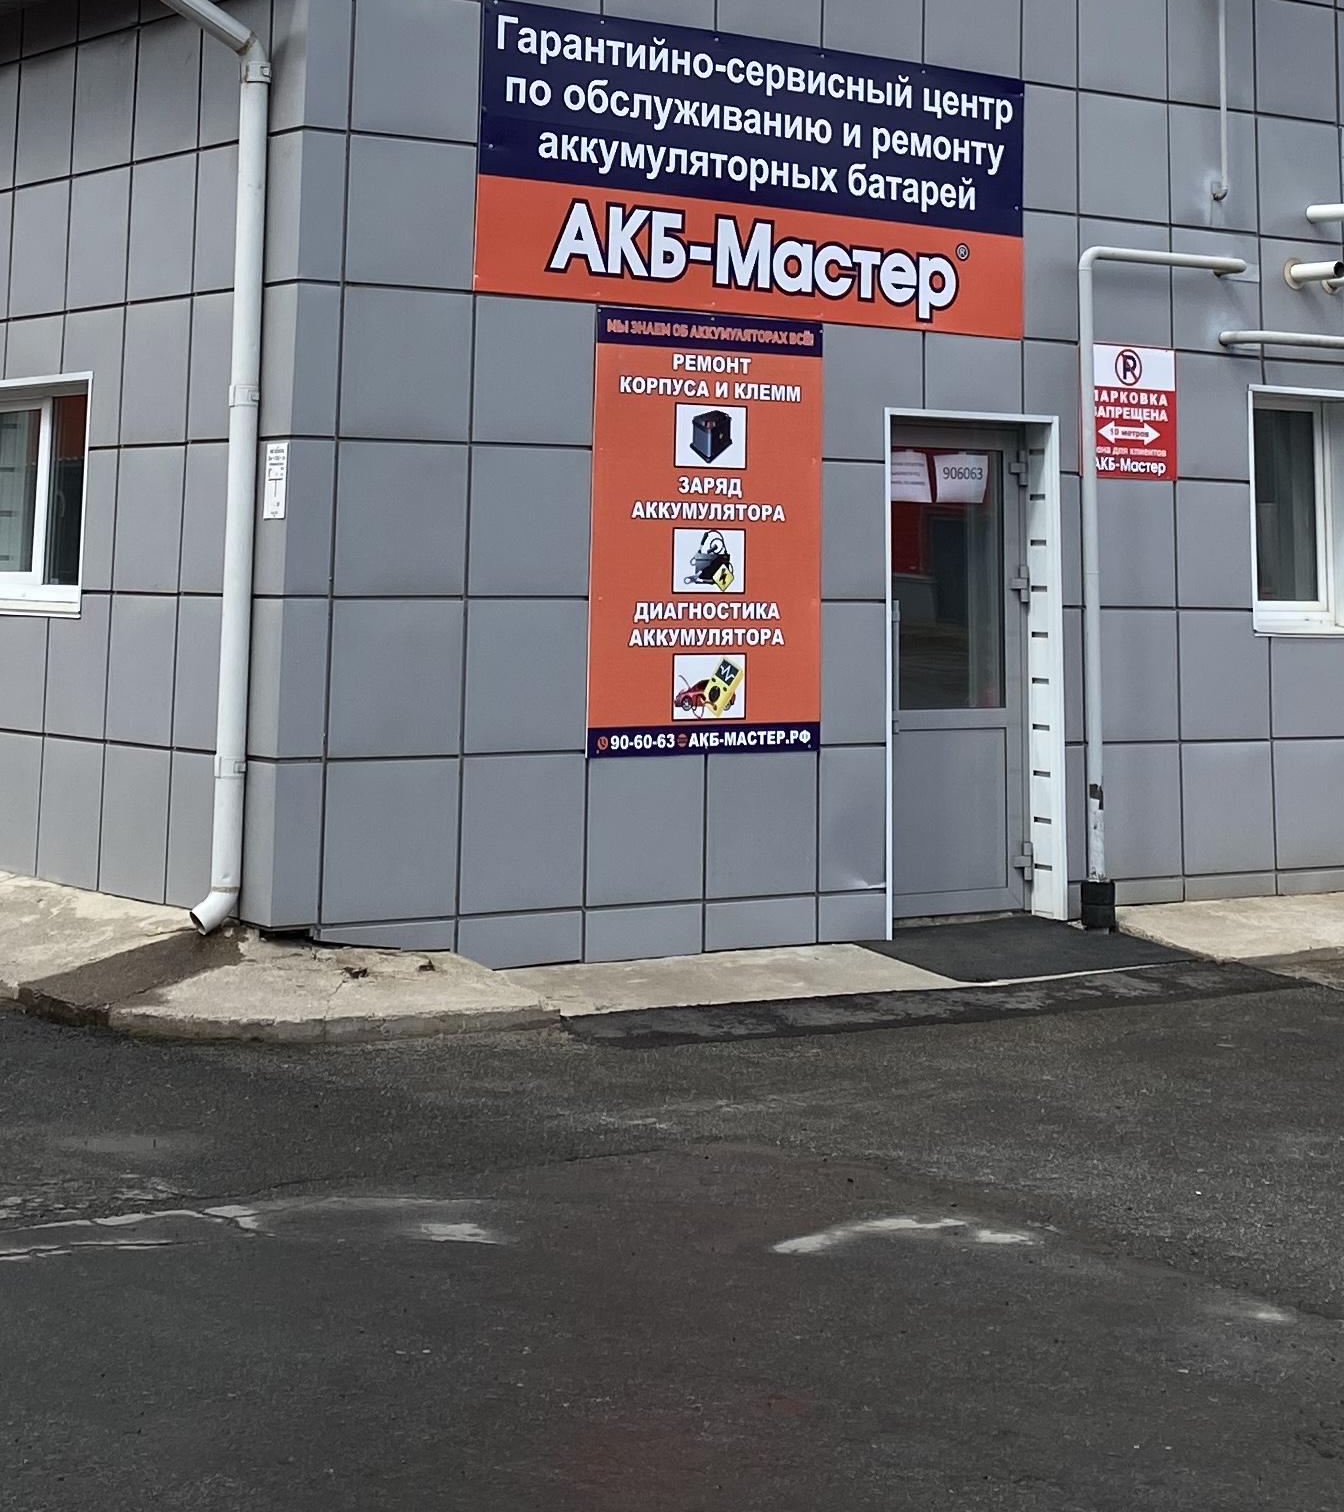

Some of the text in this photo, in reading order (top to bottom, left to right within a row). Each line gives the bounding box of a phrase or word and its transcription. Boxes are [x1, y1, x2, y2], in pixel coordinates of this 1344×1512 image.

[497, 14, 1014, 129] Гарантийно-сервисный центр
[506, 75, 1005, 174] по обслуживанию и ремонту
[538, 131, 976, 210] аккумуляторных батарей
[607, 319, 629, 333] МЫ
[631, 321, 671, 337] ЗНАЕМ
[672, 324, 688, 338] ОБ
[689, 326, 788, 345] АККУМУЛЯТОРАХ
[673, 354, 752, 374] РЕМОНТ
[619, 375, 801, 402] КОРПУСА И КЛЕММ
[1094, 405, 1169, 422] АПРЕЩЕНА
[1110, 428, 1150, 439] 10 метров
[1096, 446, 1111, 454] она
[942, 467, 983, 480] 906063
[678, 476, 743, 499] ЗАРЯД
[631, 501, 786, 522] АККУМУЛЯТОРА
[633, 602, 781, 623] ДИАГНОСТИКА
[628, 628, 785, 647] АККУМУЛЯТОРА
[610, 729, 811, 750] 90-60-63 АКБ-МАСТЕР.РФ
